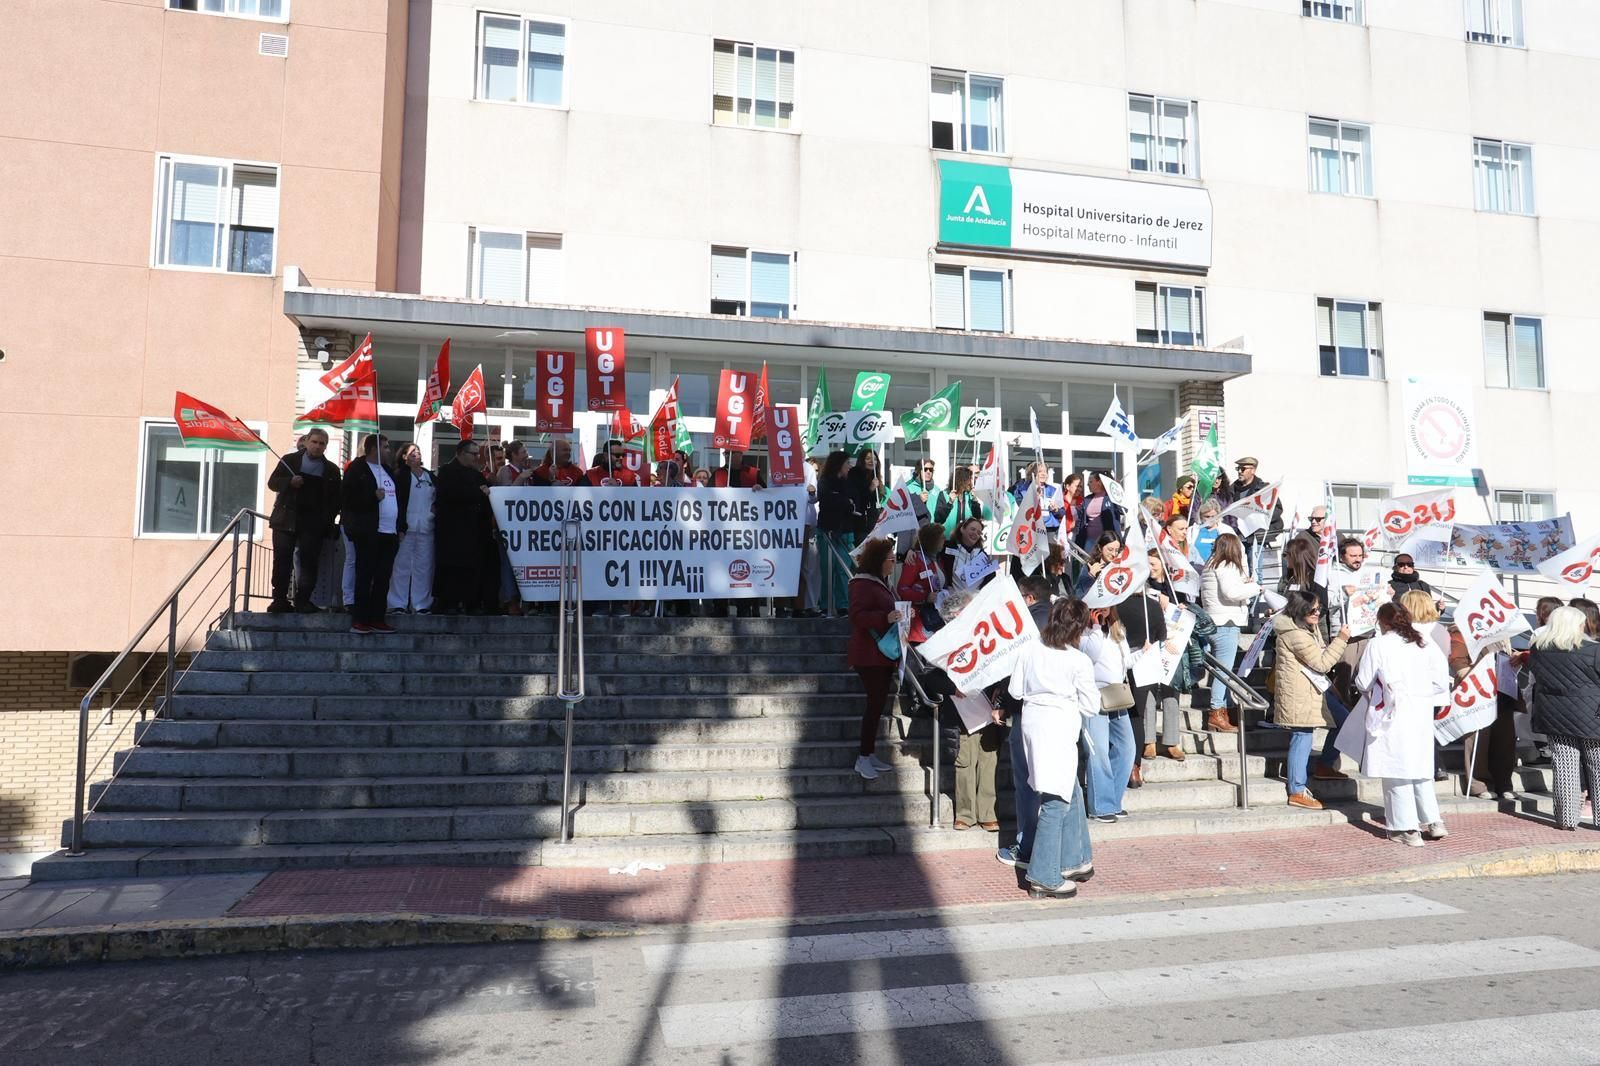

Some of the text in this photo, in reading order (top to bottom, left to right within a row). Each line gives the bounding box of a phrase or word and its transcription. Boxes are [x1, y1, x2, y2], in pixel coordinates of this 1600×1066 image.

[946, 214, 964, 223] Junta
[975, 216, 1007, 226] Andalucía
[1023, 202, 1203, 231] Hospital Universitario de Jerez
[1023, 223, 1074, 239] Hospital
[1077, 228, 1127, 245] Materno
[1136, 234, 1178, 249] Infantil
[595, 331, 614, 395] UGT
[547, 354, 564, 418] UGT
[727, 374, 747, 435] UGT
[774, 409, 793, 469] UGT
[504, 499, 798, 522] TODOS/AS CON LAS/OS TCAEs POR
[500, 525, 803, 552] SU RECASIFICACIÓN PROFESIONAL
[604, 559, 630, 588] C1
[731, 562, 749, 573] UGT
